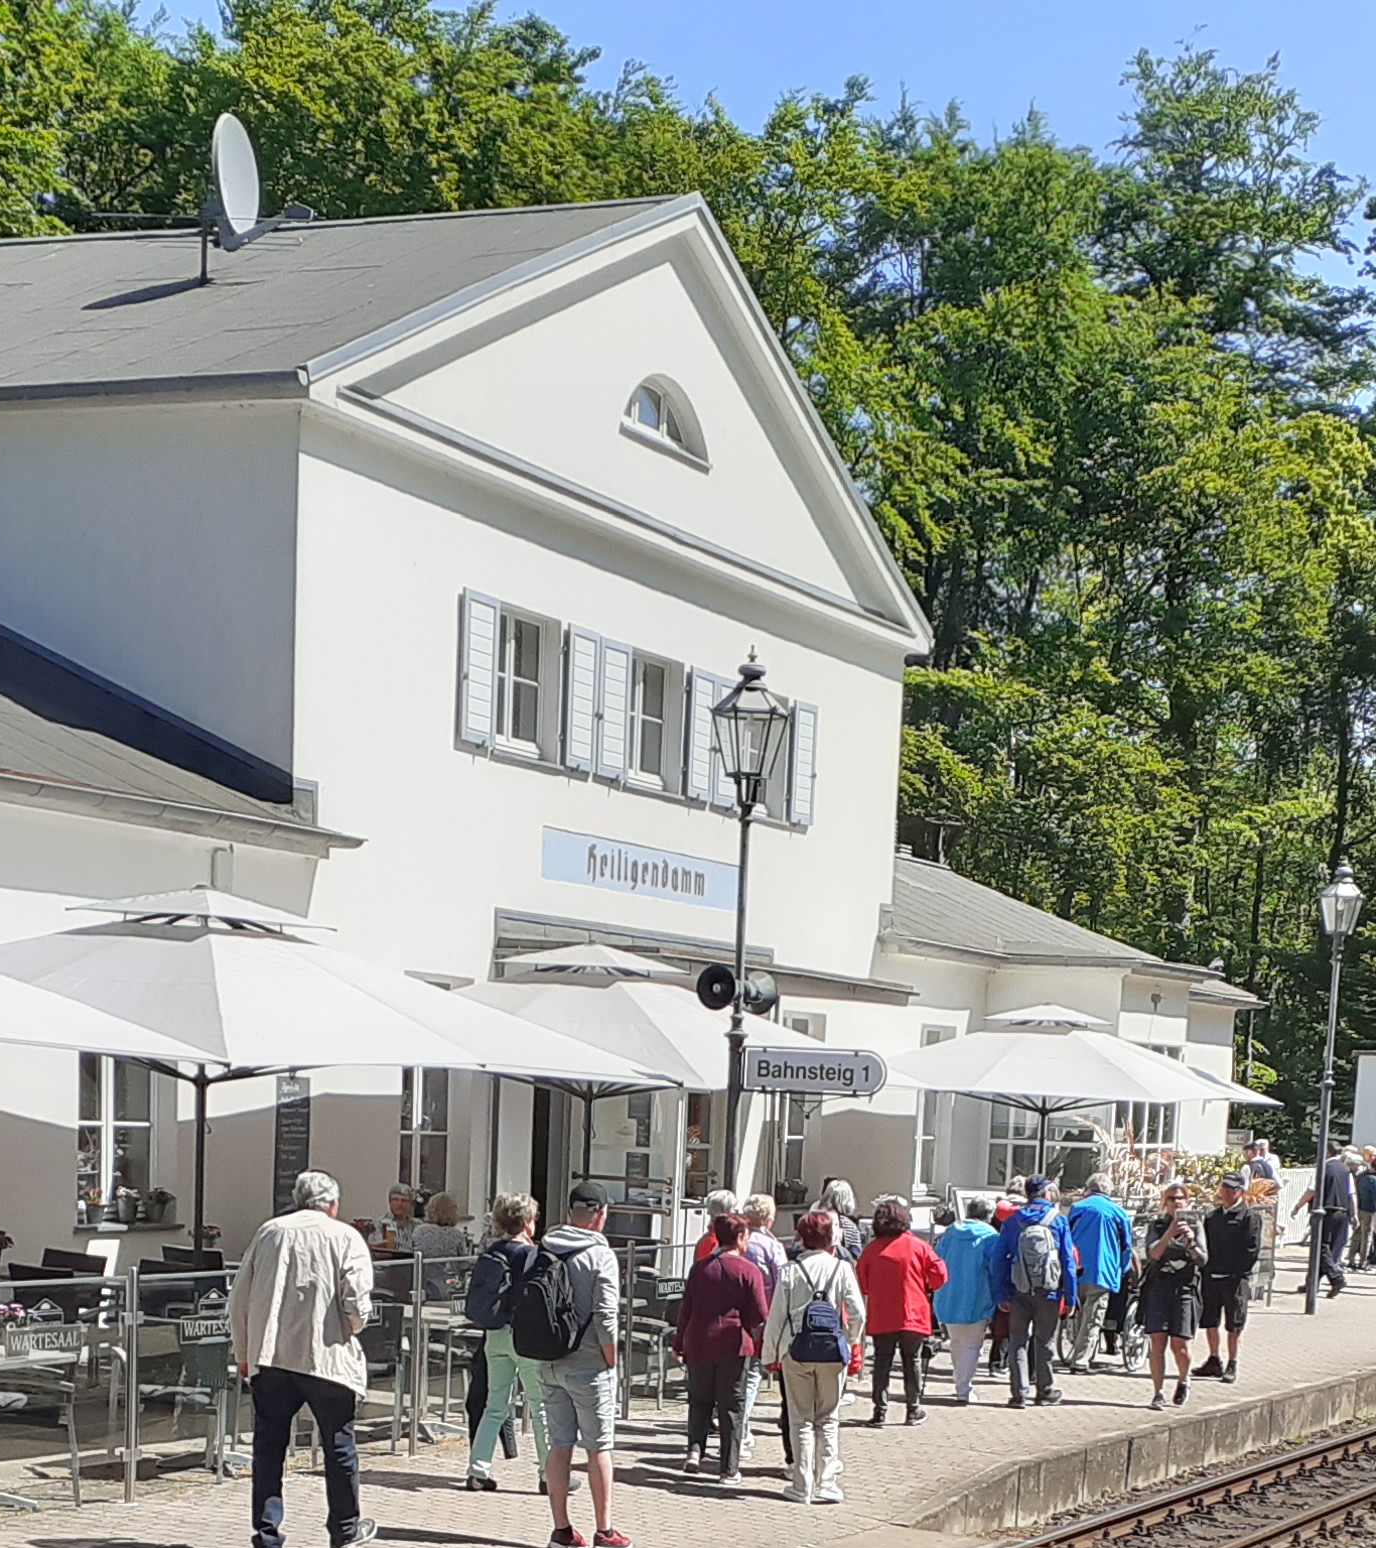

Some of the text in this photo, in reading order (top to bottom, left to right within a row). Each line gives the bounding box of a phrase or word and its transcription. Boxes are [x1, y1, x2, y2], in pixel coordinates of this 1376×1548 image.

[756, 1059, 870, 1087] Bahnsteig 1
[184, 1320, 232, 1337] WARTESA
[10, 1330, 80, 1352] WARTESAAL
